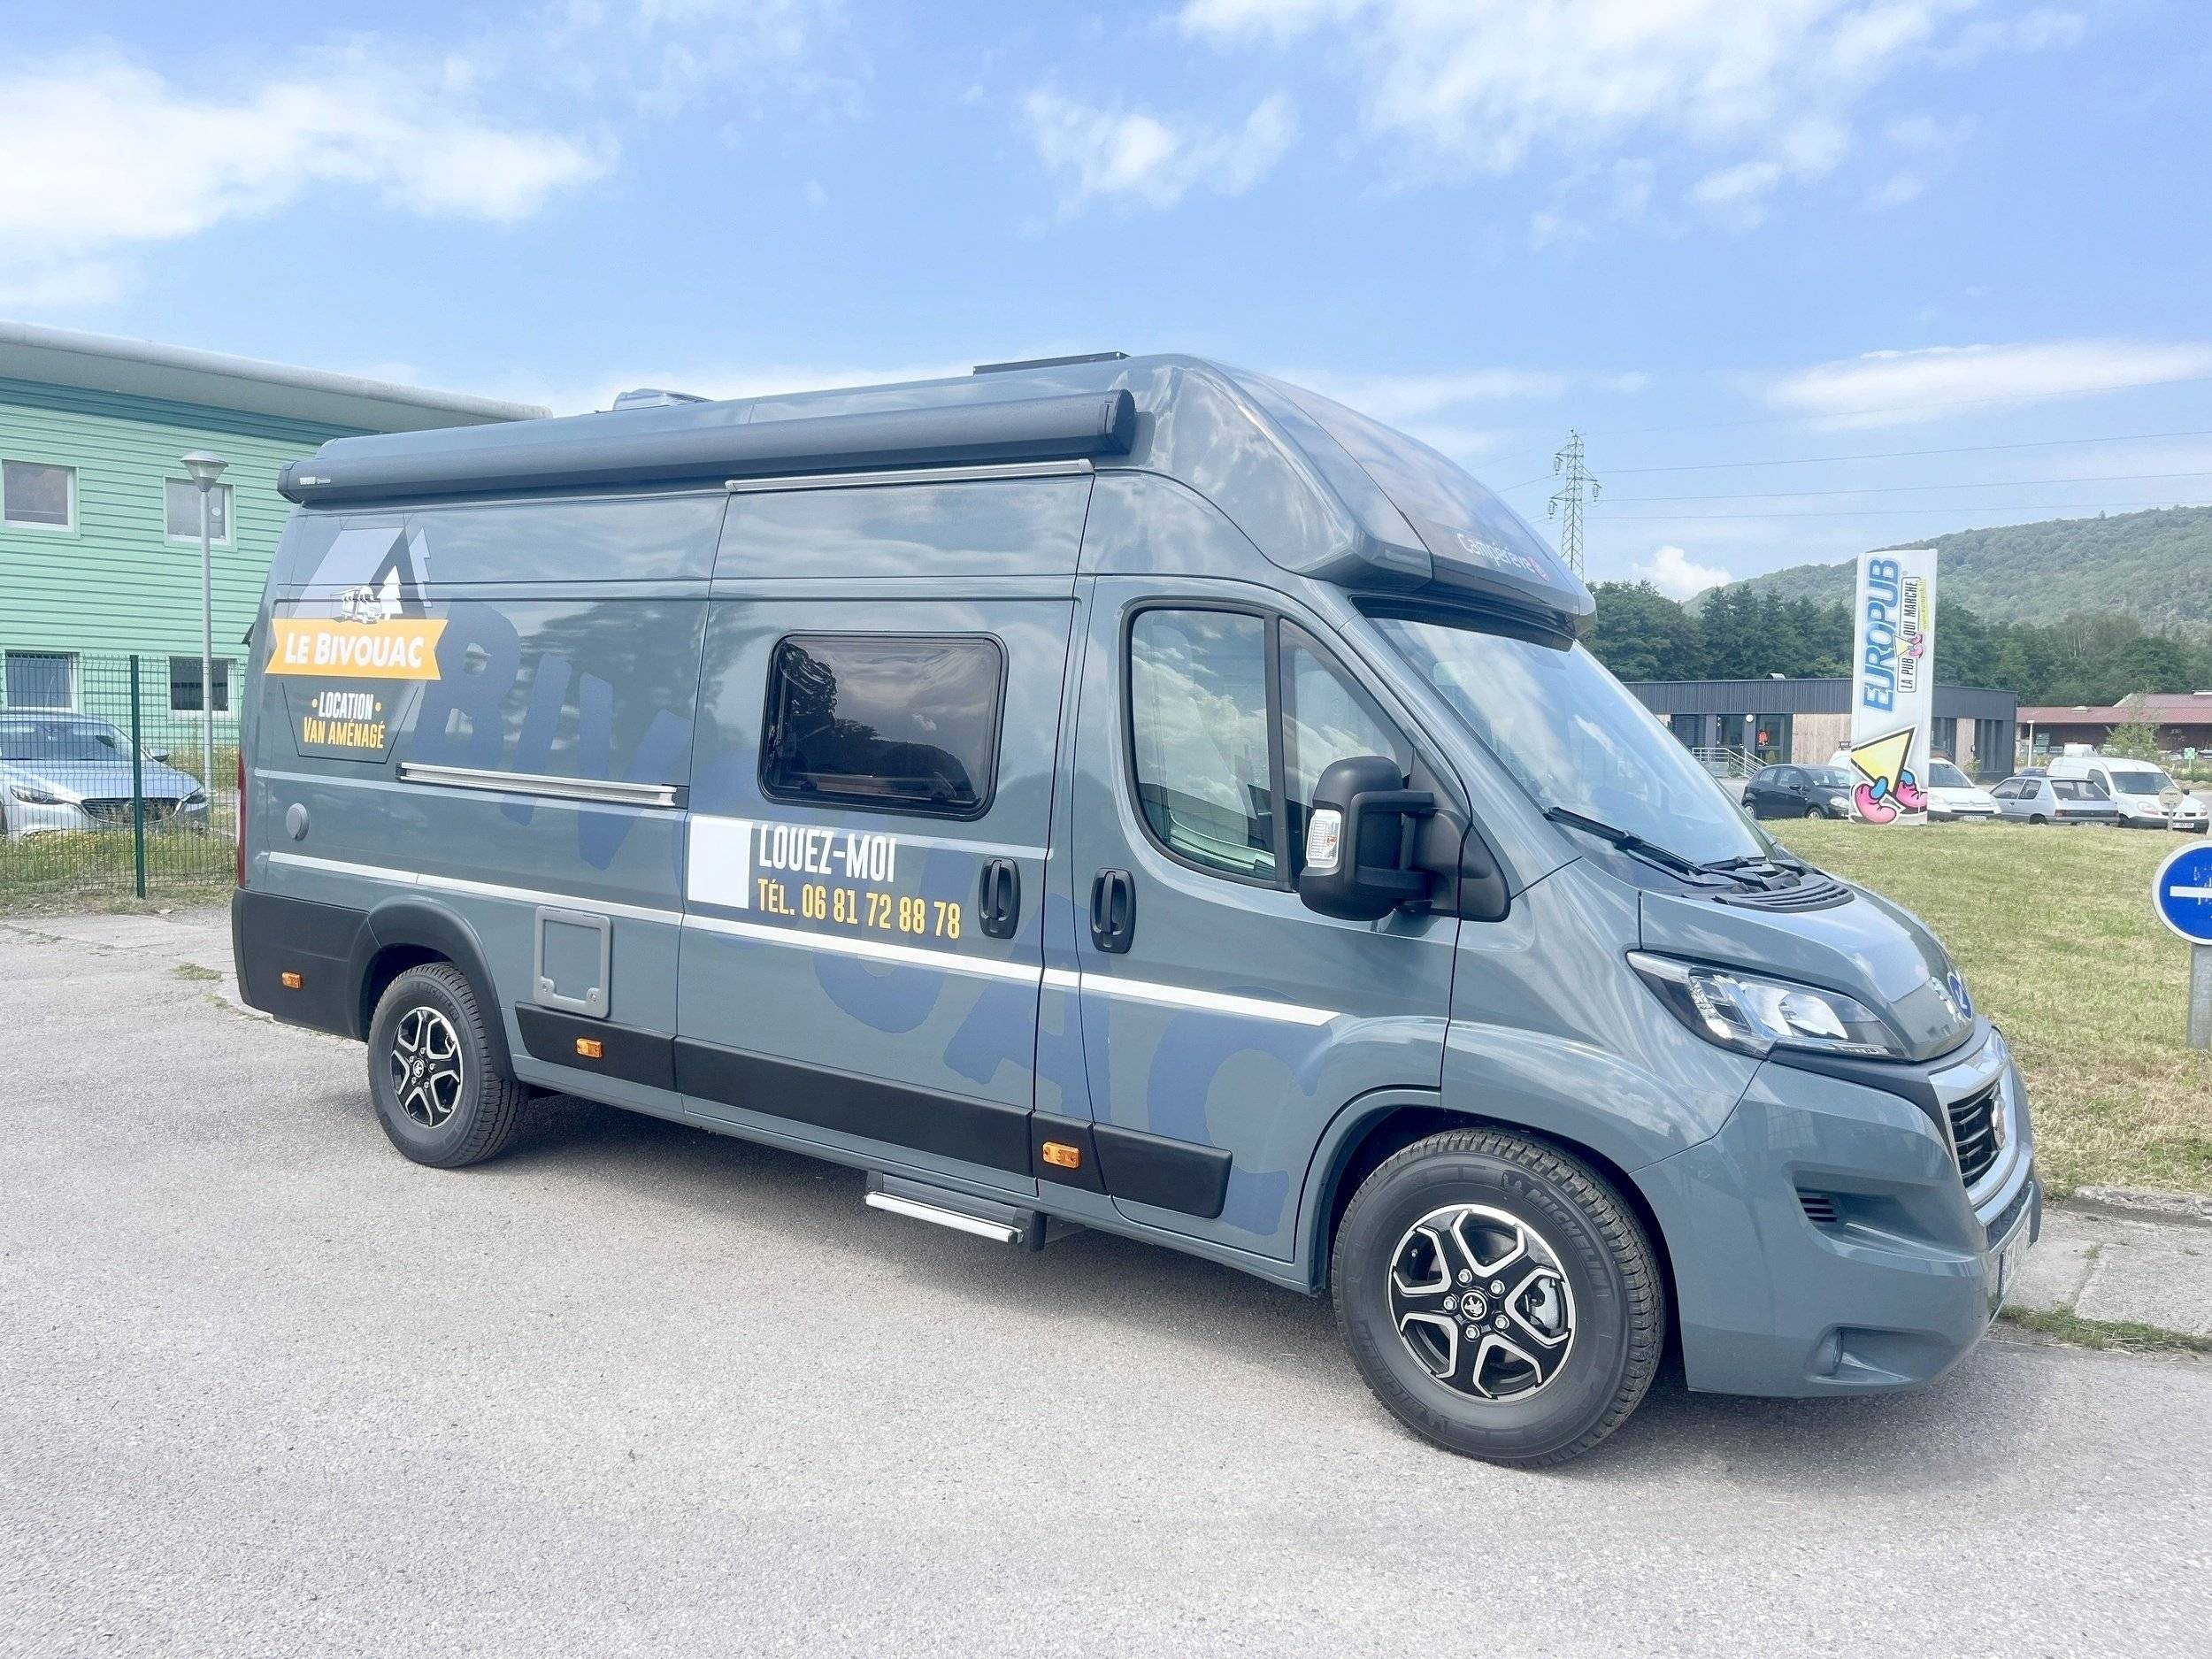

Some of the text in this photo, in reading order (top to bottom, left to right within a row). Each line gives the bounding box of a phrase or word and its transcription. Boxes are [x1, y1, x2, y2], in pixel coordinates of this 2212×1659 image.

[1863, 559, 1899, 712] EUROPUB
[1902, 620, 1916, 636] QUI
[284, 632, 425, 669] LE BIVOUAC
[1901, 657, 1914, 676] PUB
[1901, 679, 1913, 689] LA
[319, 691, 374, 720] LOCATION
[303, 717, 386, 749] VAN AMÉNAGÉ
[759, 824, 897, 883] LOUEZ-MOI
[757, 878, 961, 939] TÉL. 06 81 72 88 78
[1524, 1188, 1611, 1290] MICHELIN
